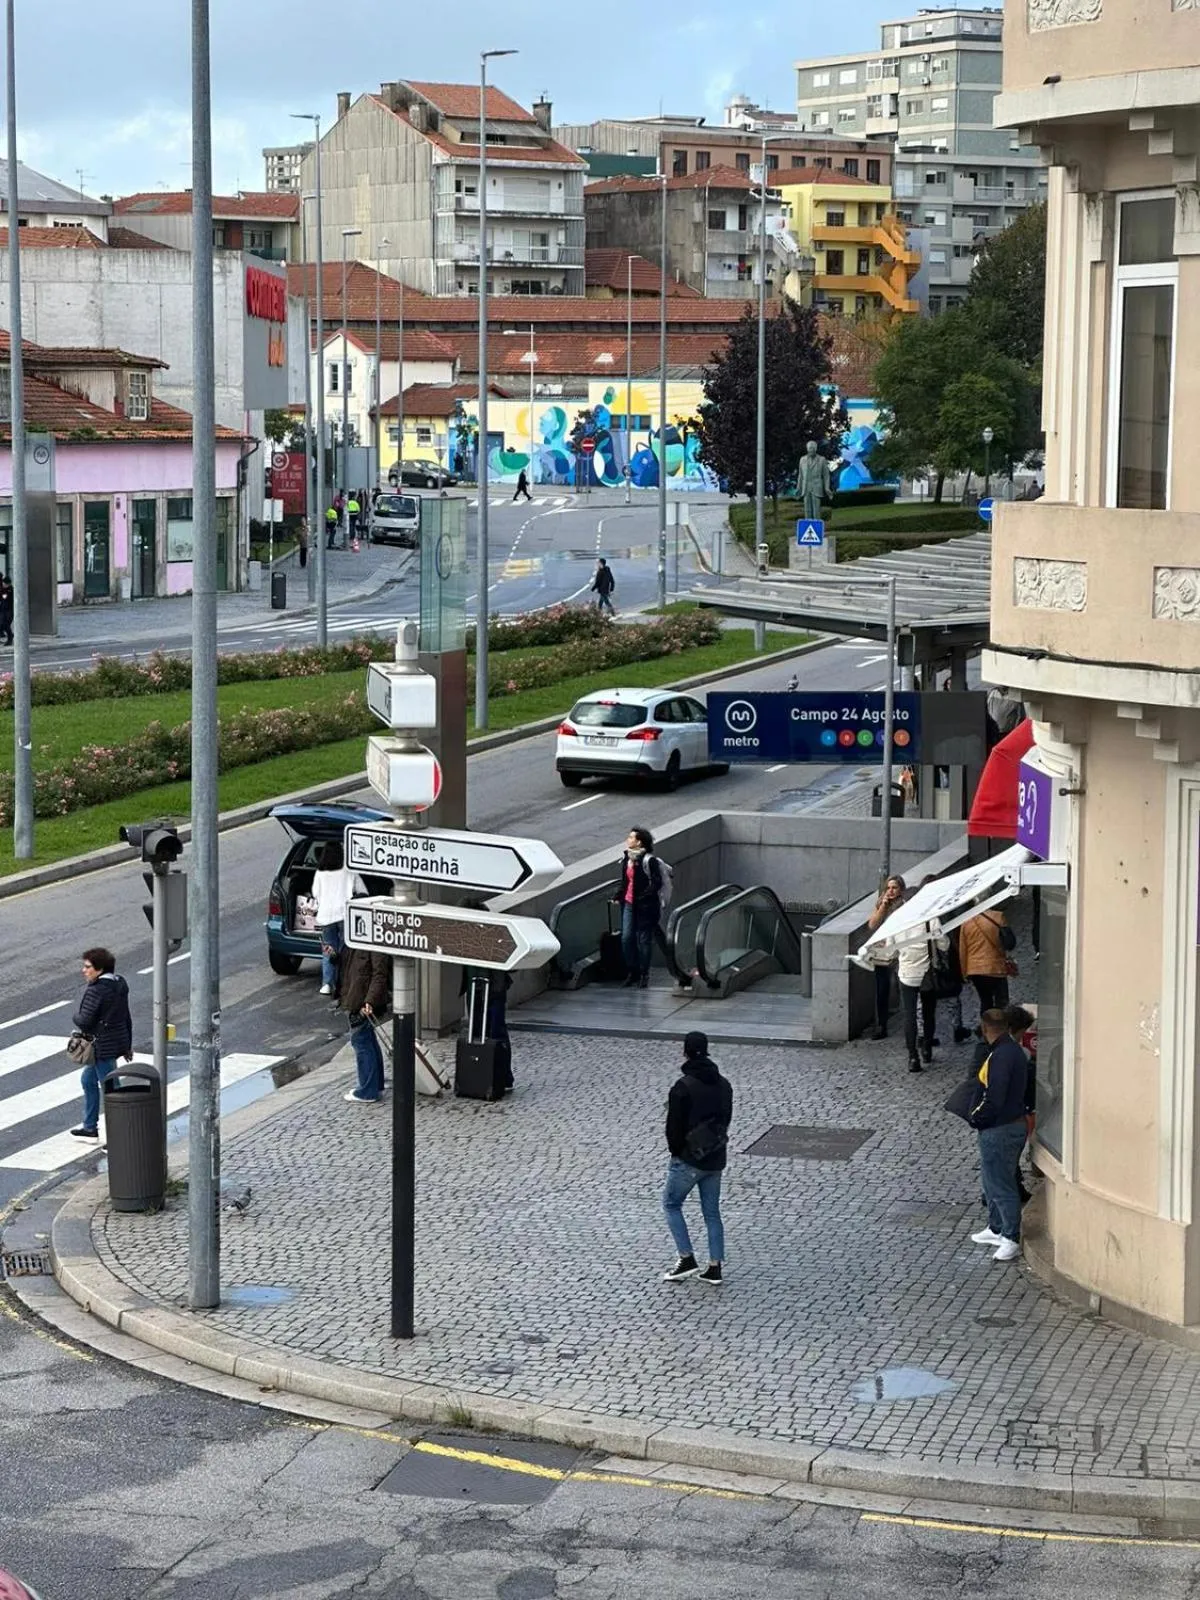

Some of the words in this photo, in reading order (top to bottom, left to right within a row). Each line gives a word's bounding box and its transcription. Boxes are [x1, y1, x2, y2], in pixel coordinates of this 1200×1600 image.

[791, 708, 838, 723] Campo
[841, 708, 858, 720] 24
[724, 736, 760, 746] metro
[375, 834, 418, 851] estação
[422, 839, 436, 852] de
[375, 847, 459, 876] Campanhã
[373, 908, 404, 927] igreja
[406, 912, 422, 927] do
[373, 925, 429, 949] Bonfim
